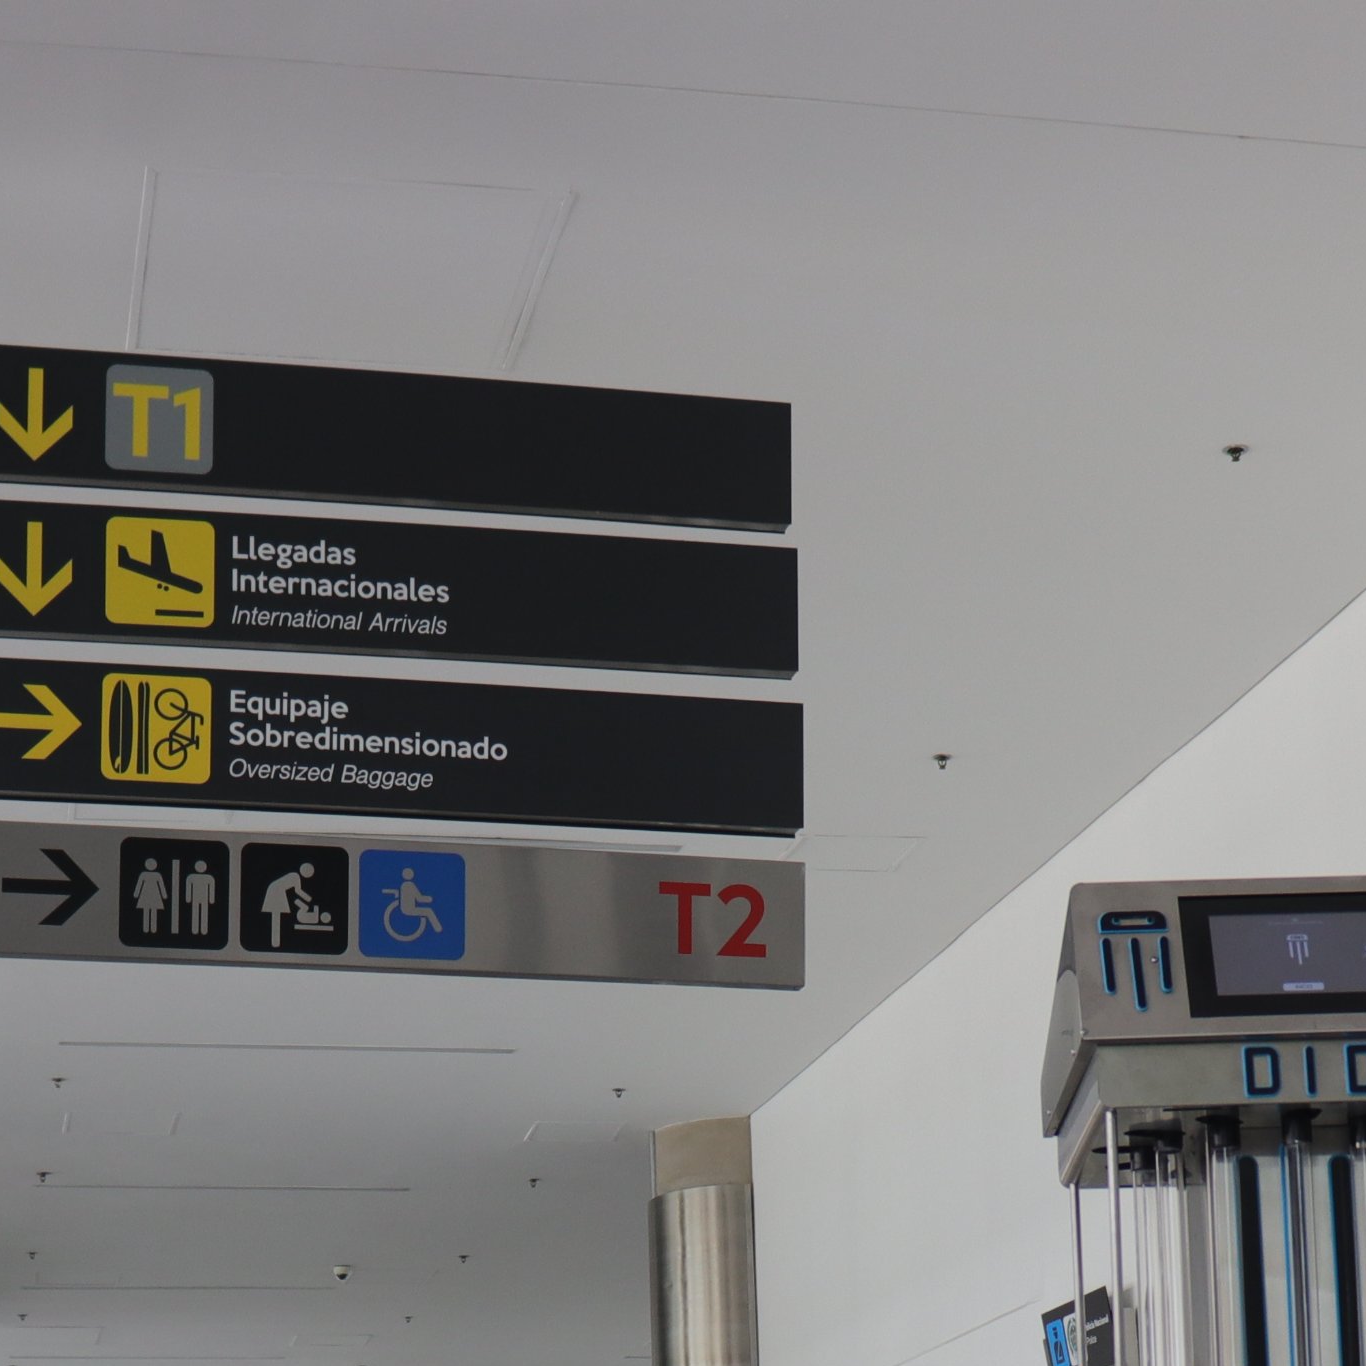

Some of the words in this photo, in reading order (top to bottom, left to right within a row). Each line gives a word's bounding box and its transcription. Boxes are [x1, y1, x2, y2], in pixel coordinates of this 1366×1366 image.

[112, 382, 202, 461] T1
[232, 535, 357, 569] Llegadas
[232, 568, 450, 603] Internacionales
[231, 605, 363, 631] International
[368, 611, 448, 635] Arrivals
[229, 689, 349, 724] Equipaje
[229, 721, 508, 761] Sobredimensionado
[229, 757, 335, 783] Oversized
[340, 763, 434, 791] Baggage
[658, 881, 767, 958] T2
